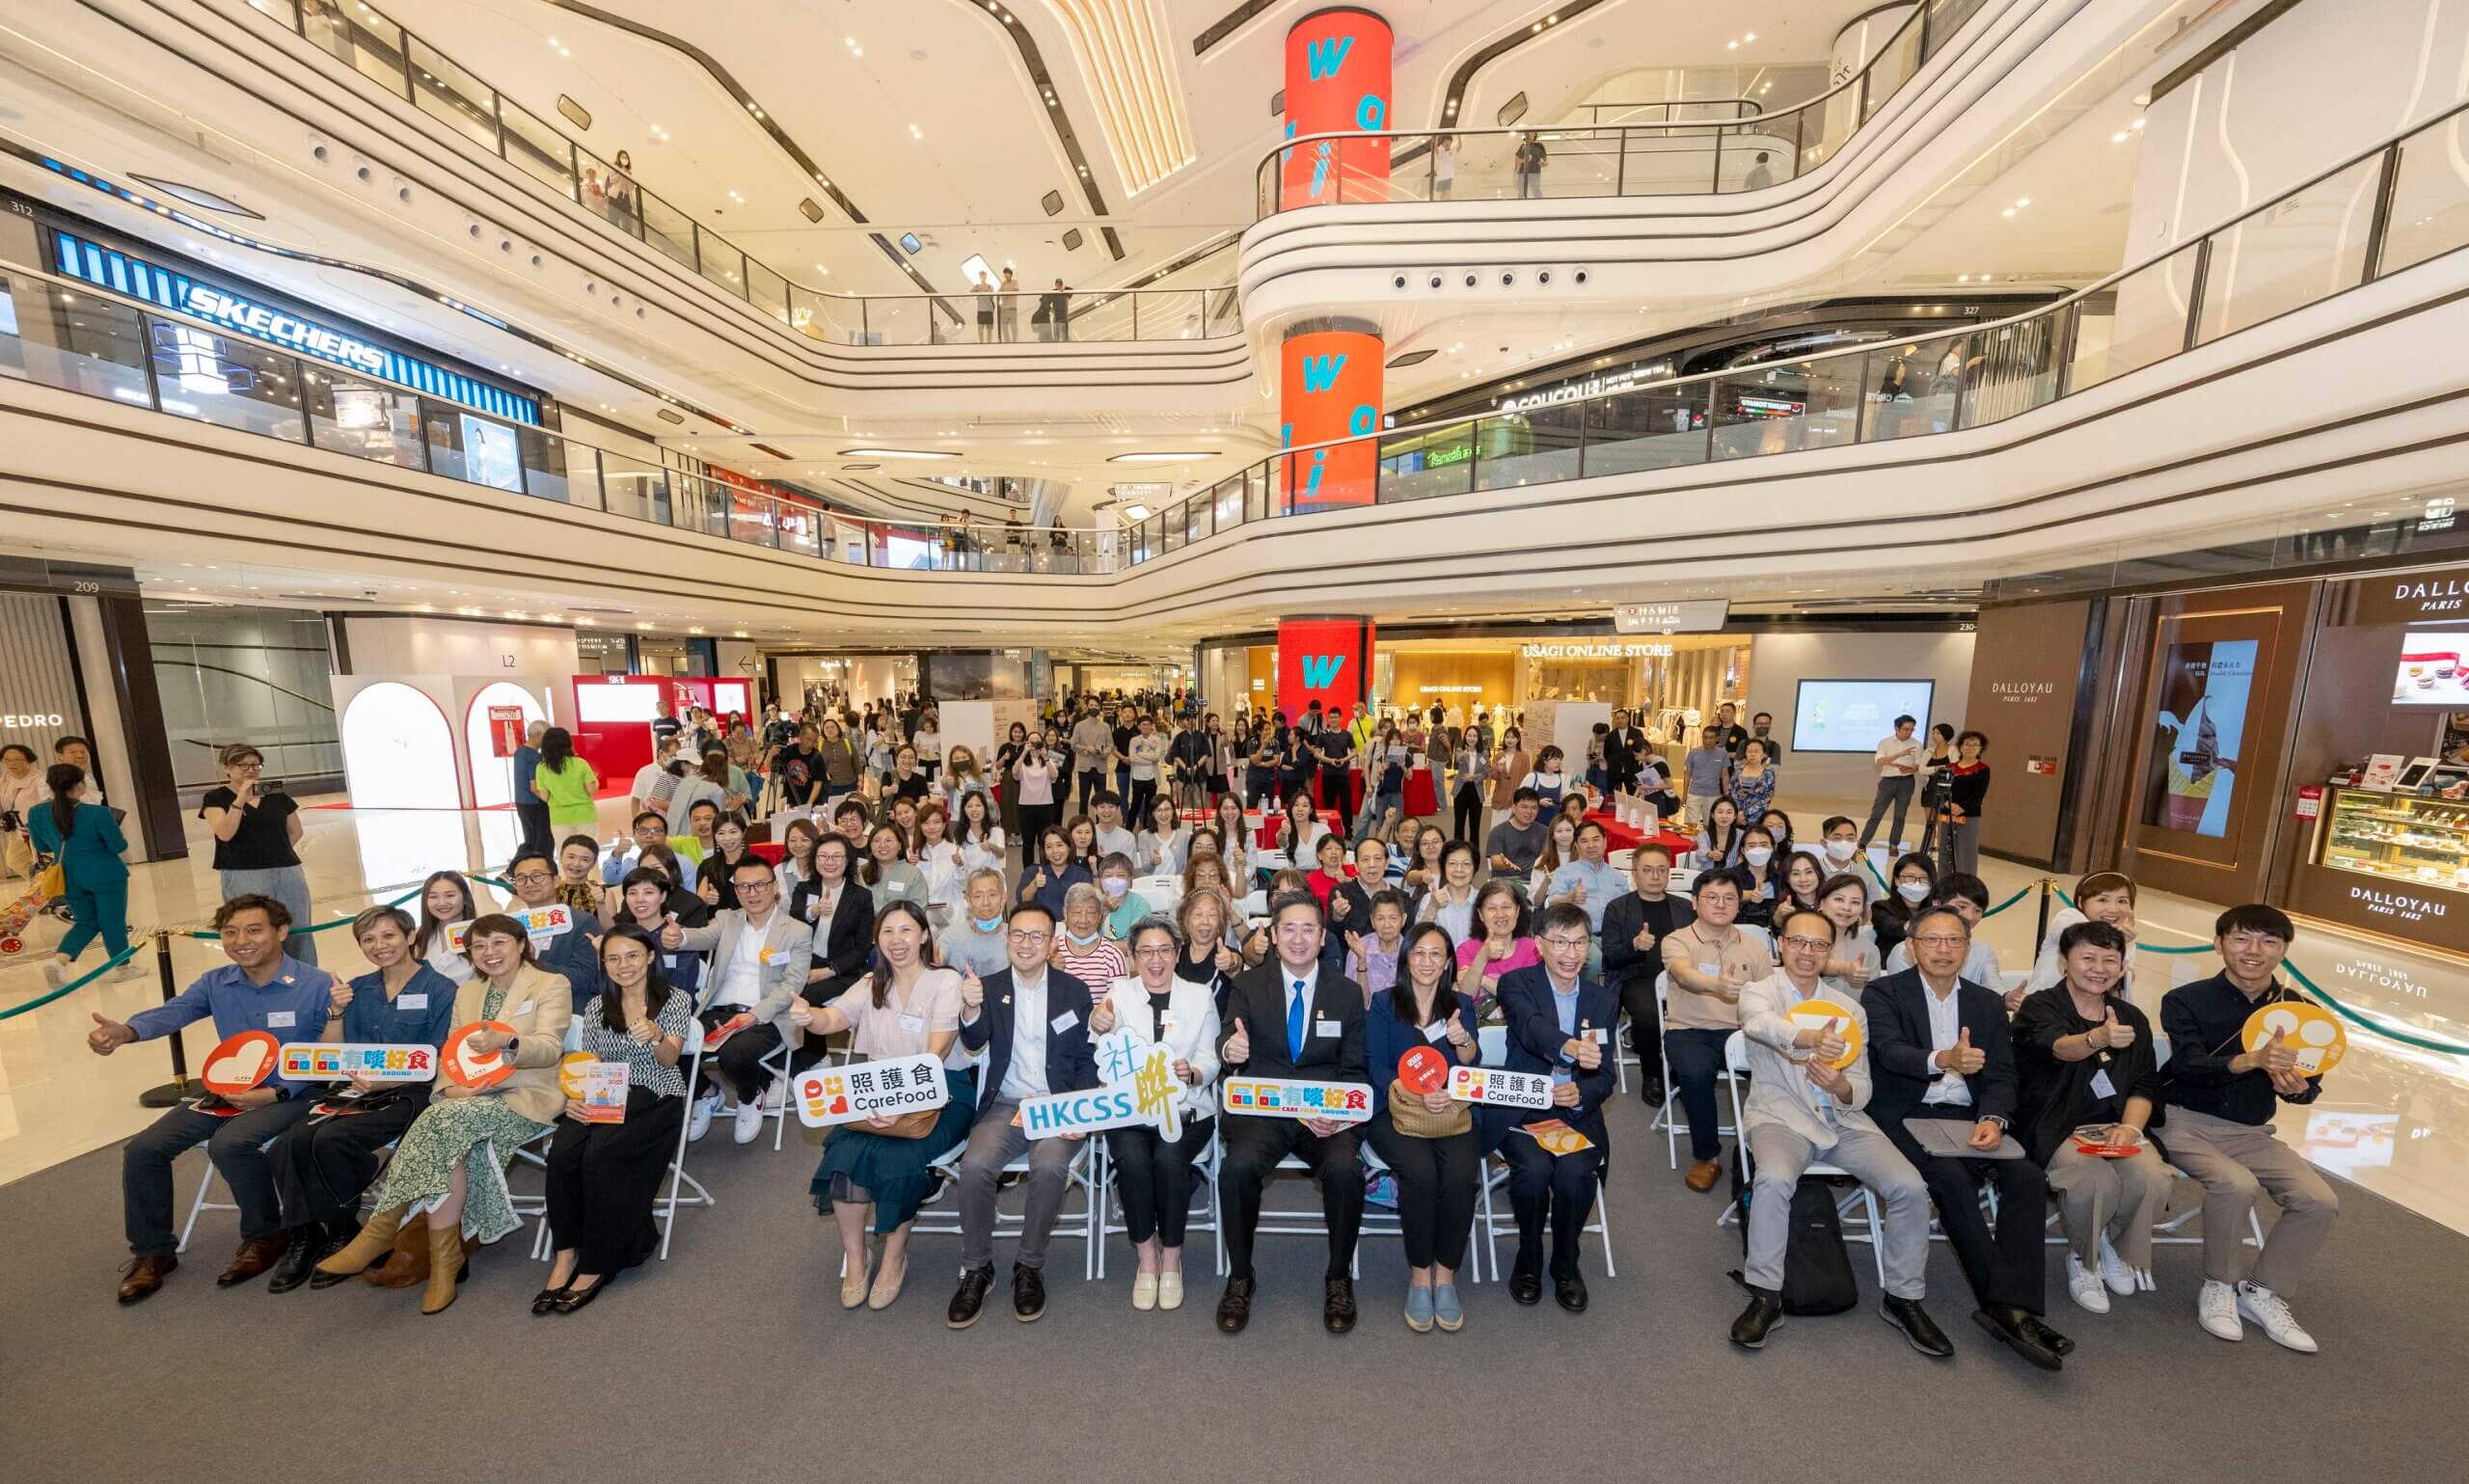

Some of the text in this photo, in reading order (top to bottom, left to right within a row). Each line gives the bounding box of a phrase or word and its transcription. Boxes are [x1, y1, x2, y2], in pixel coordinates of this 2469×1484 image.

[12, 201, 34, 217] 312
[1964, 306, 1980, 315] 327
[188, 286, 386, 369] SKECHERS
[74, 580, 99, 593] 209
[2421, 600, 2463, 611] PARIS
[1523, 644, 1673, 658] USAGI ONLINE STORE
[502, 656, 515, 667] L2
[1992, 683, 2053, 693] DALLOYAU
[0, 714, 63, 728] EDRO
[2350, 886, 2447, 916] DALLOYAU
[2367, 904, 2423, 921] PARIS 1682
[851, 1063, 935, 1095] 照護食
[1489, 1073, 1546, 1094] 照護食
[855, 1087, 937, 1111] CareFood
[1487, 1091, 1545, 1106] CareFood
[1028, 1093, 1133, 1131] HKCSS
